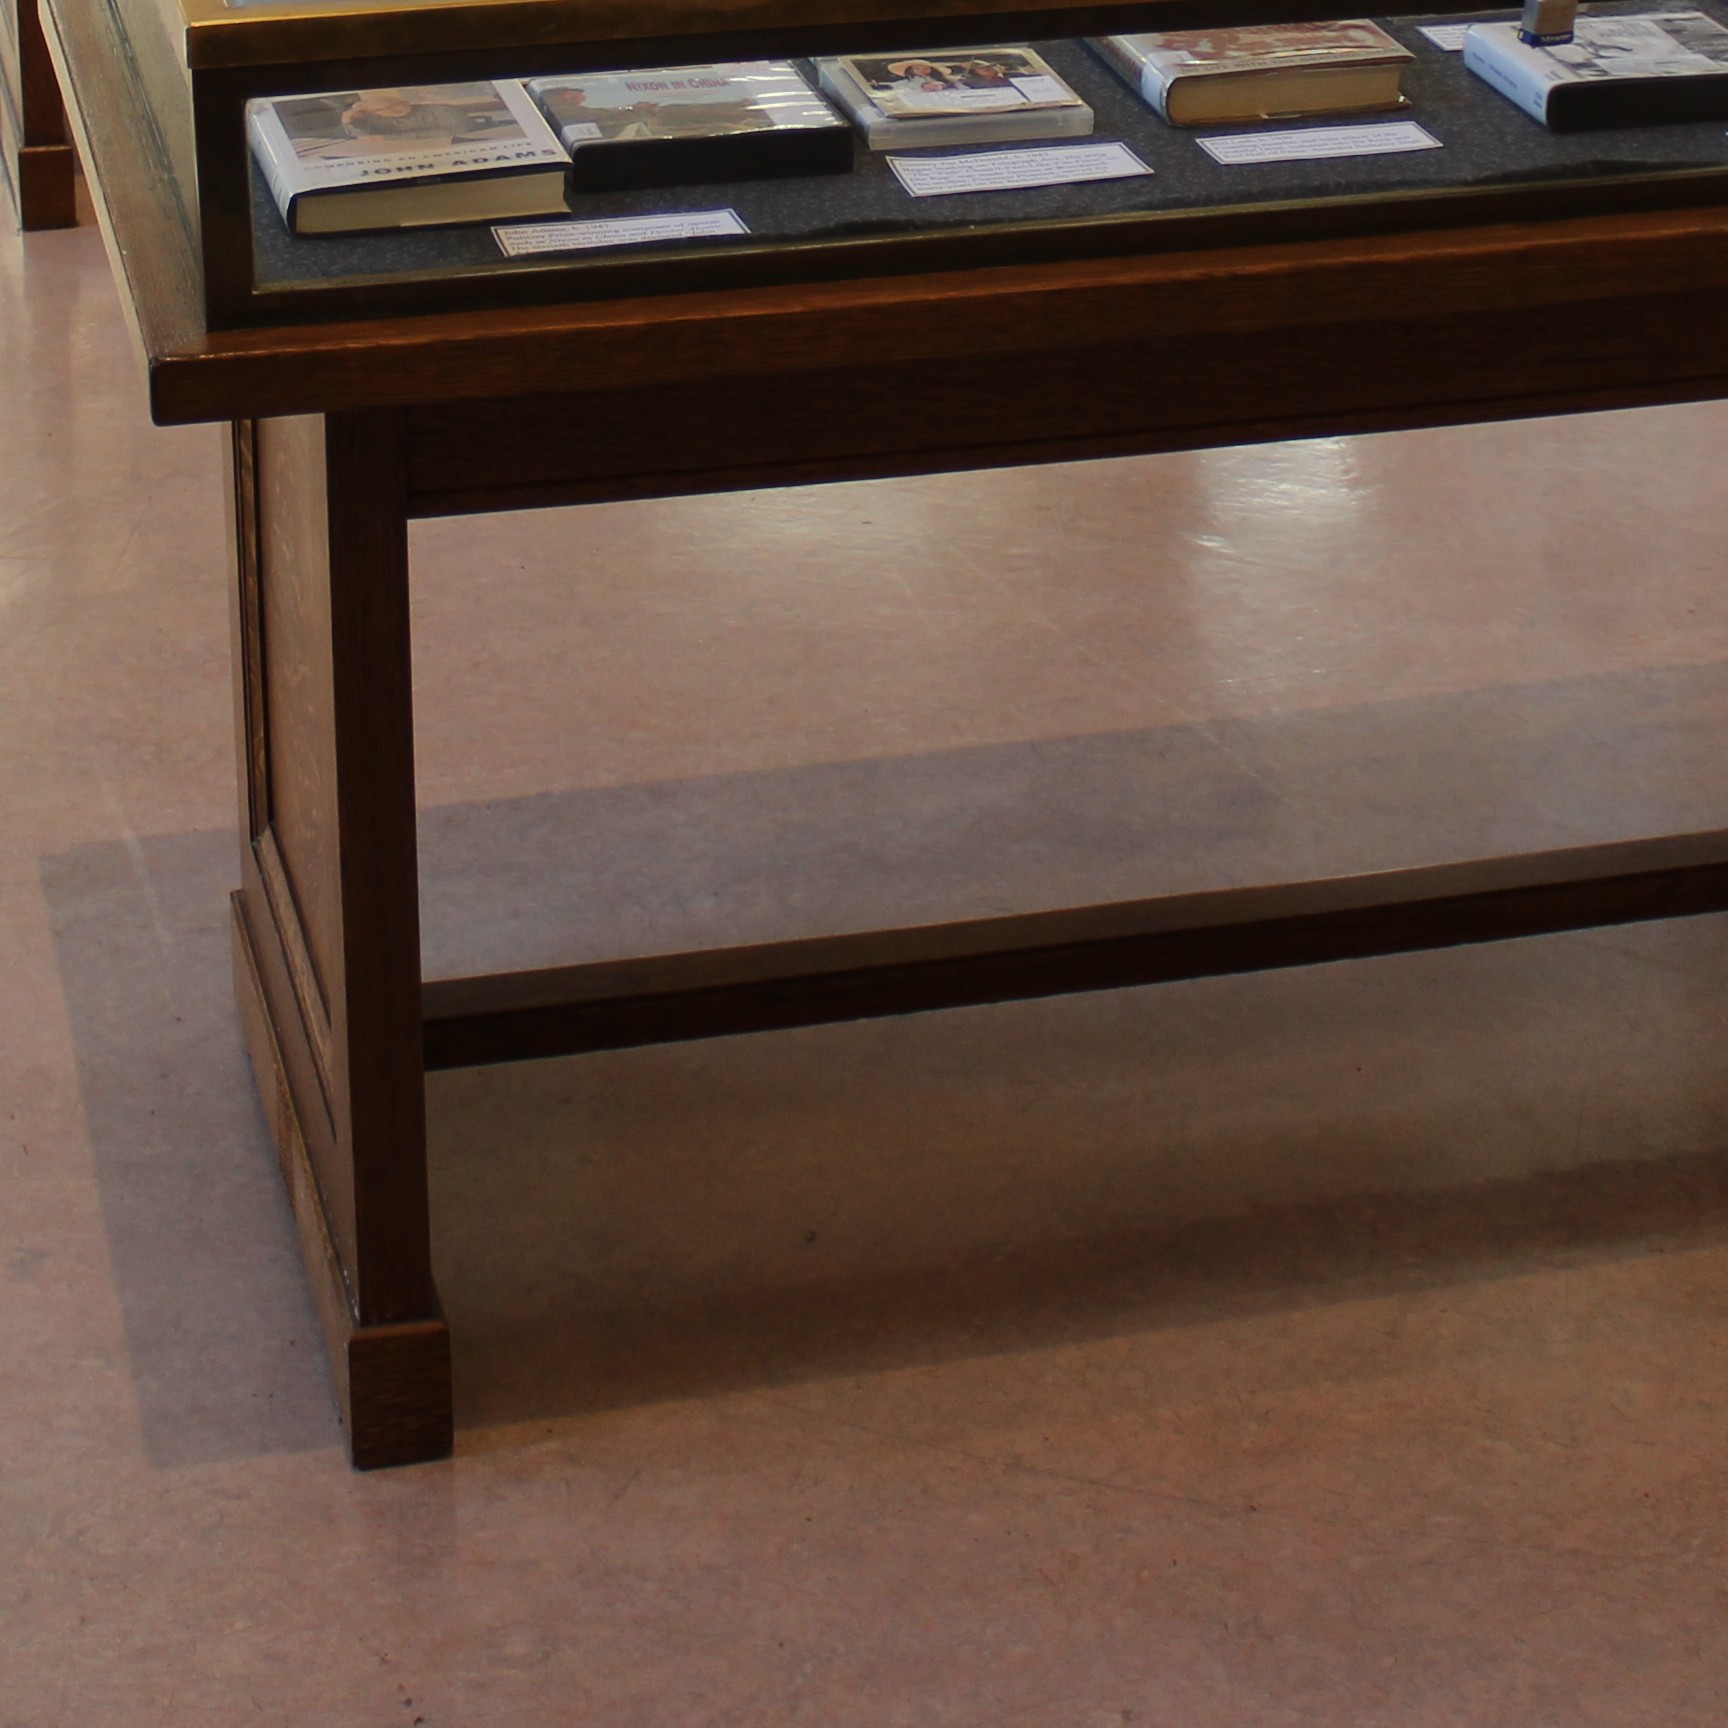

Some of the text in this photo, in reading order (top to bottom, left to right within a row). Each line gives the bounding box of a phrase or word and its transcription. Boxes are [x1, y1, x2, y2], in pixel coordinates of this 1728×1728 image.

[624, 77, 731, 92] NIXON IN CHINA
[361, 163, 435, 177] JOHN
[452, 149, 557, 167] ADAMS
